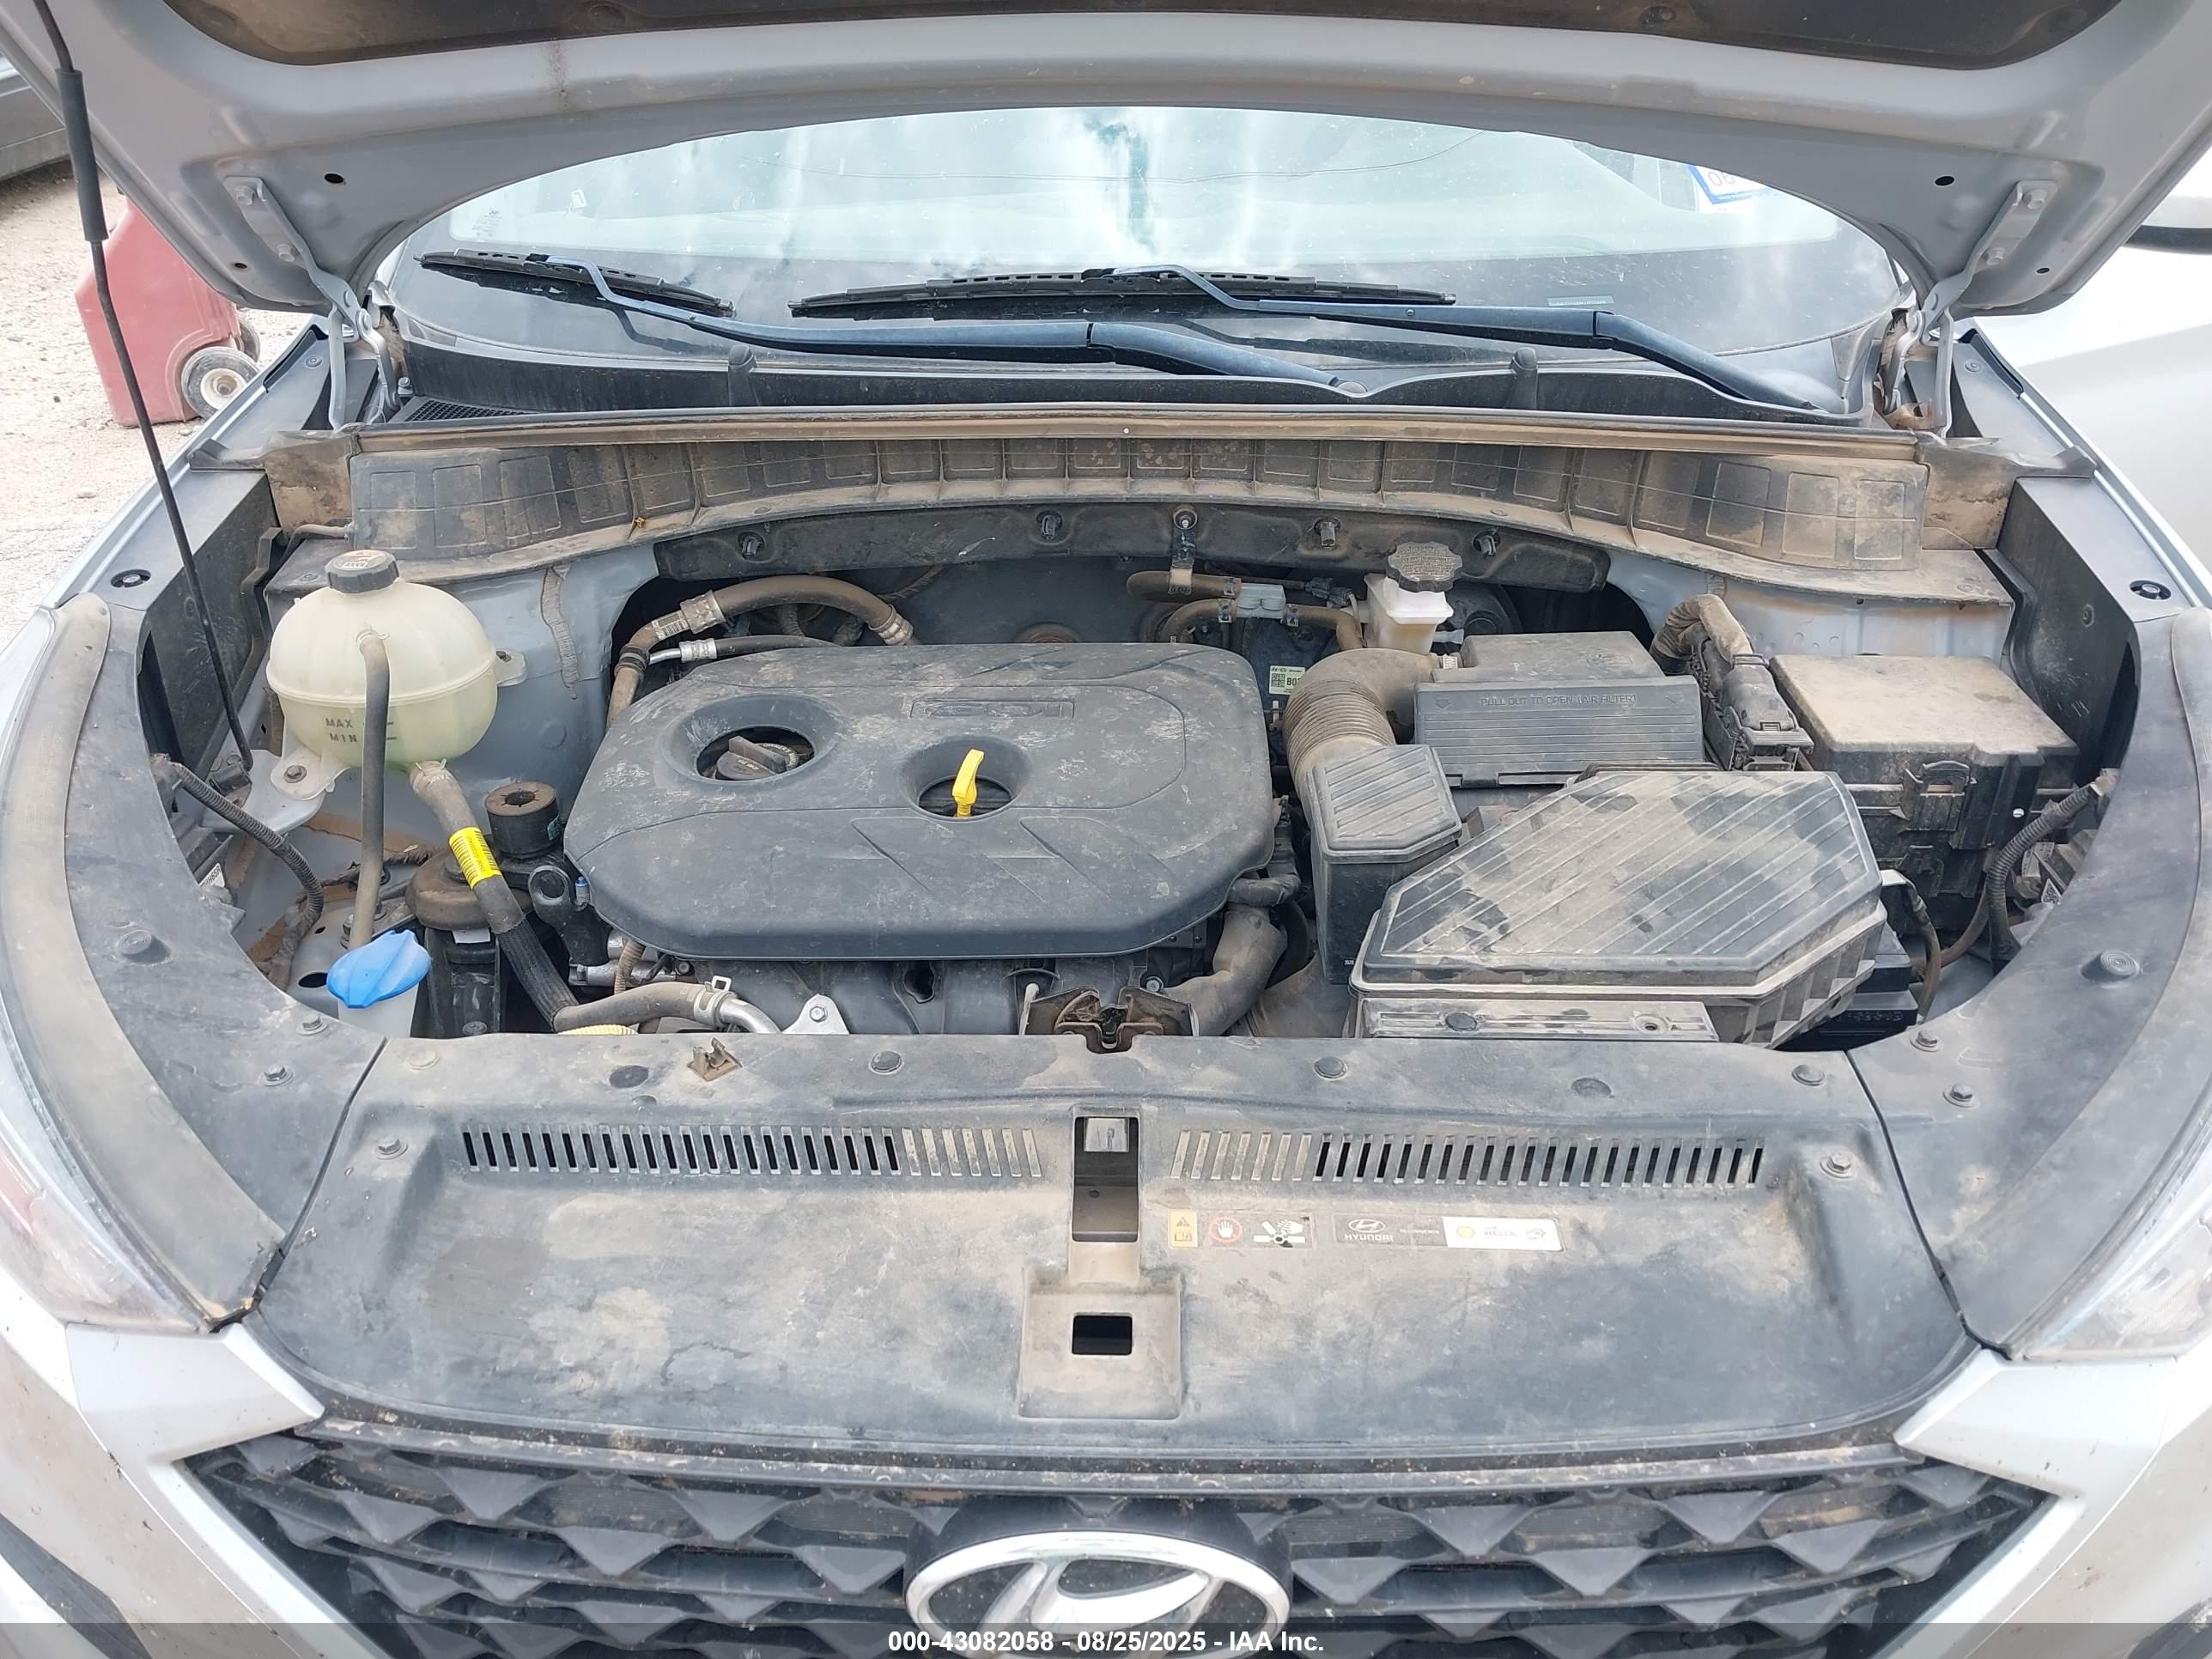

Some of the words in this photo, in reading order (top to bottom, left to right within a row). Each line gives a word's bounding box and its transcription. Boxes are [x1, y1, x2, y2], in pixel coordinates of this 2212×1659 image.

[1480, 697, 1504, 707] PULL
[1509, 696, 1527, 706] OUT
[1532, 696, 1544, 705] TO
[1547, 696, 1573, 705] OPEN
[325, 717, 354, 729] MAX
[329, 732, 357, 744] MIN
[1345, 1233, 1394, 1243] HYUNDAI
